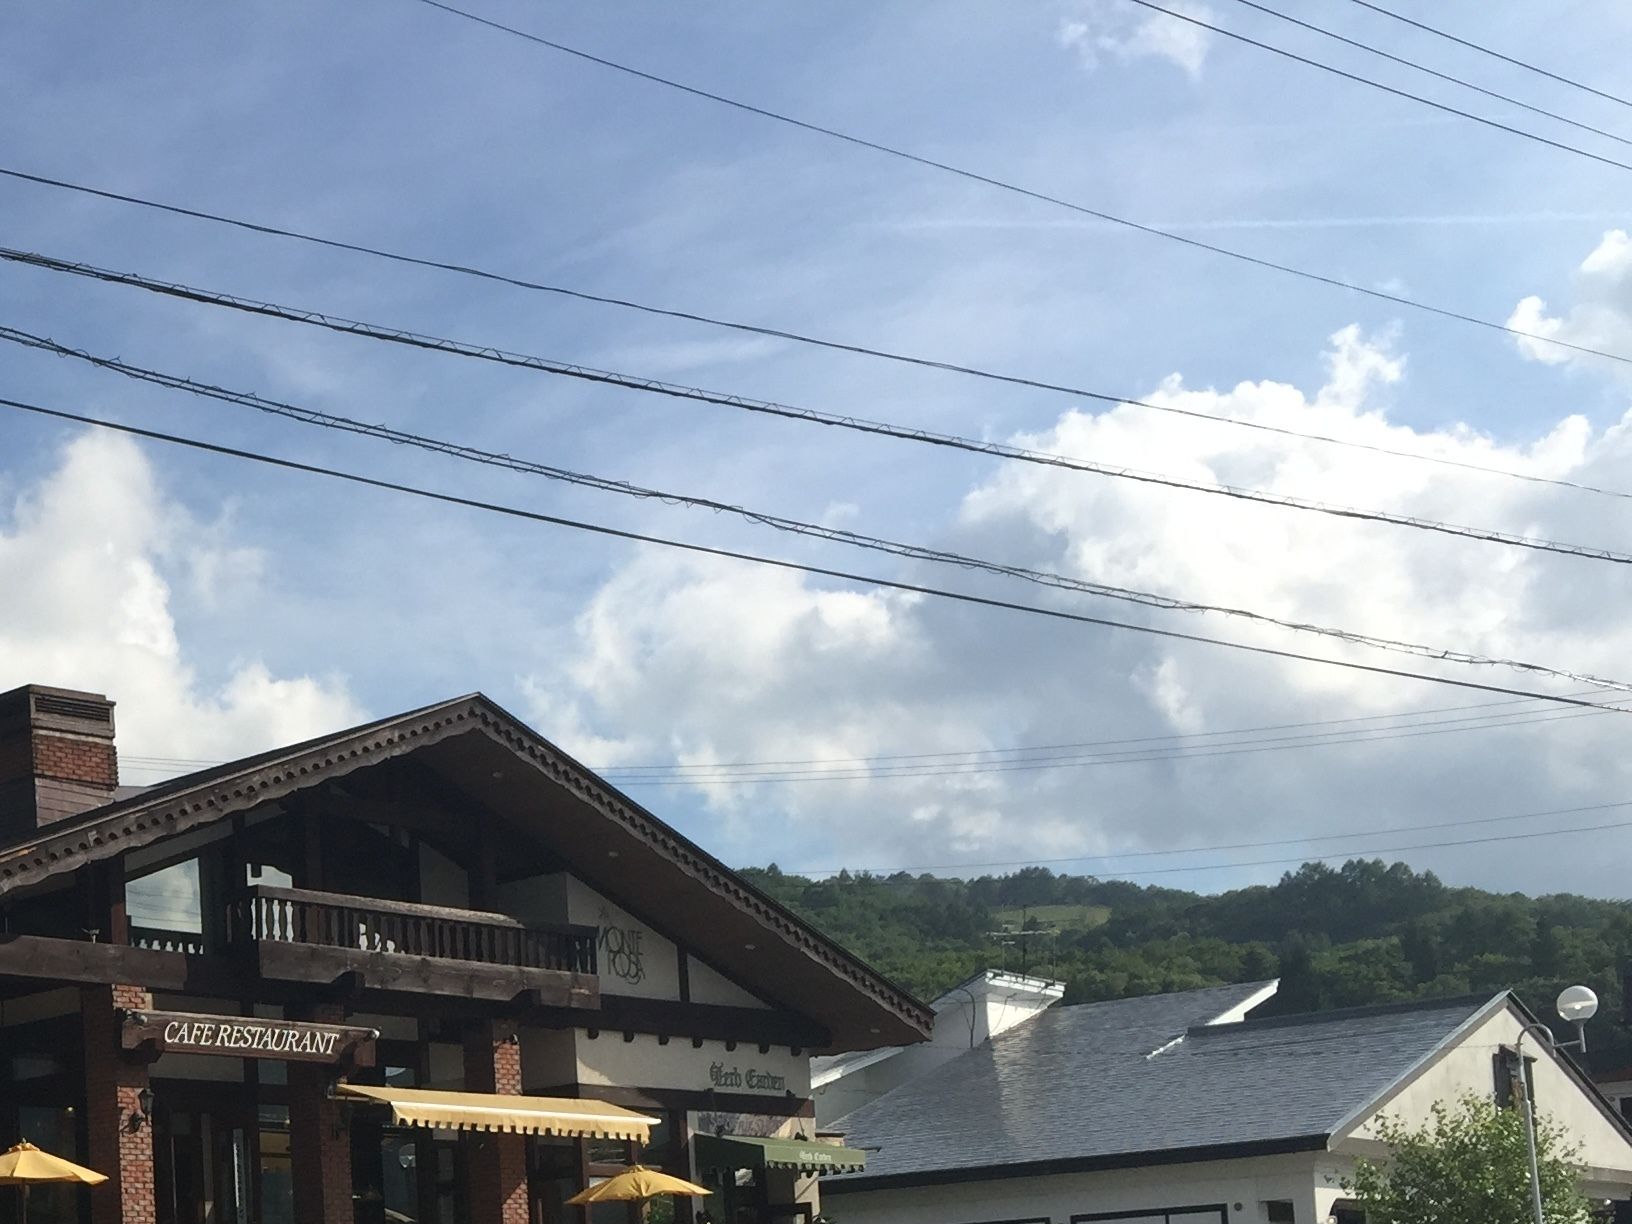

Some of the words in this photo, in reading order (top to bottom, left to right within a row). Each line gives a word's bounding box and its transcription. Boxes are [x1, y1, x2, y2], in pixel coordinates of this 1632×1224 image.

[164, 1020, 216, 1047] CAFE
[215, 1024, 340, 1055] RESTAURANT
[709, 1060, 743, 1088] Herb
[744, 1068, 785, 1091] Garden
